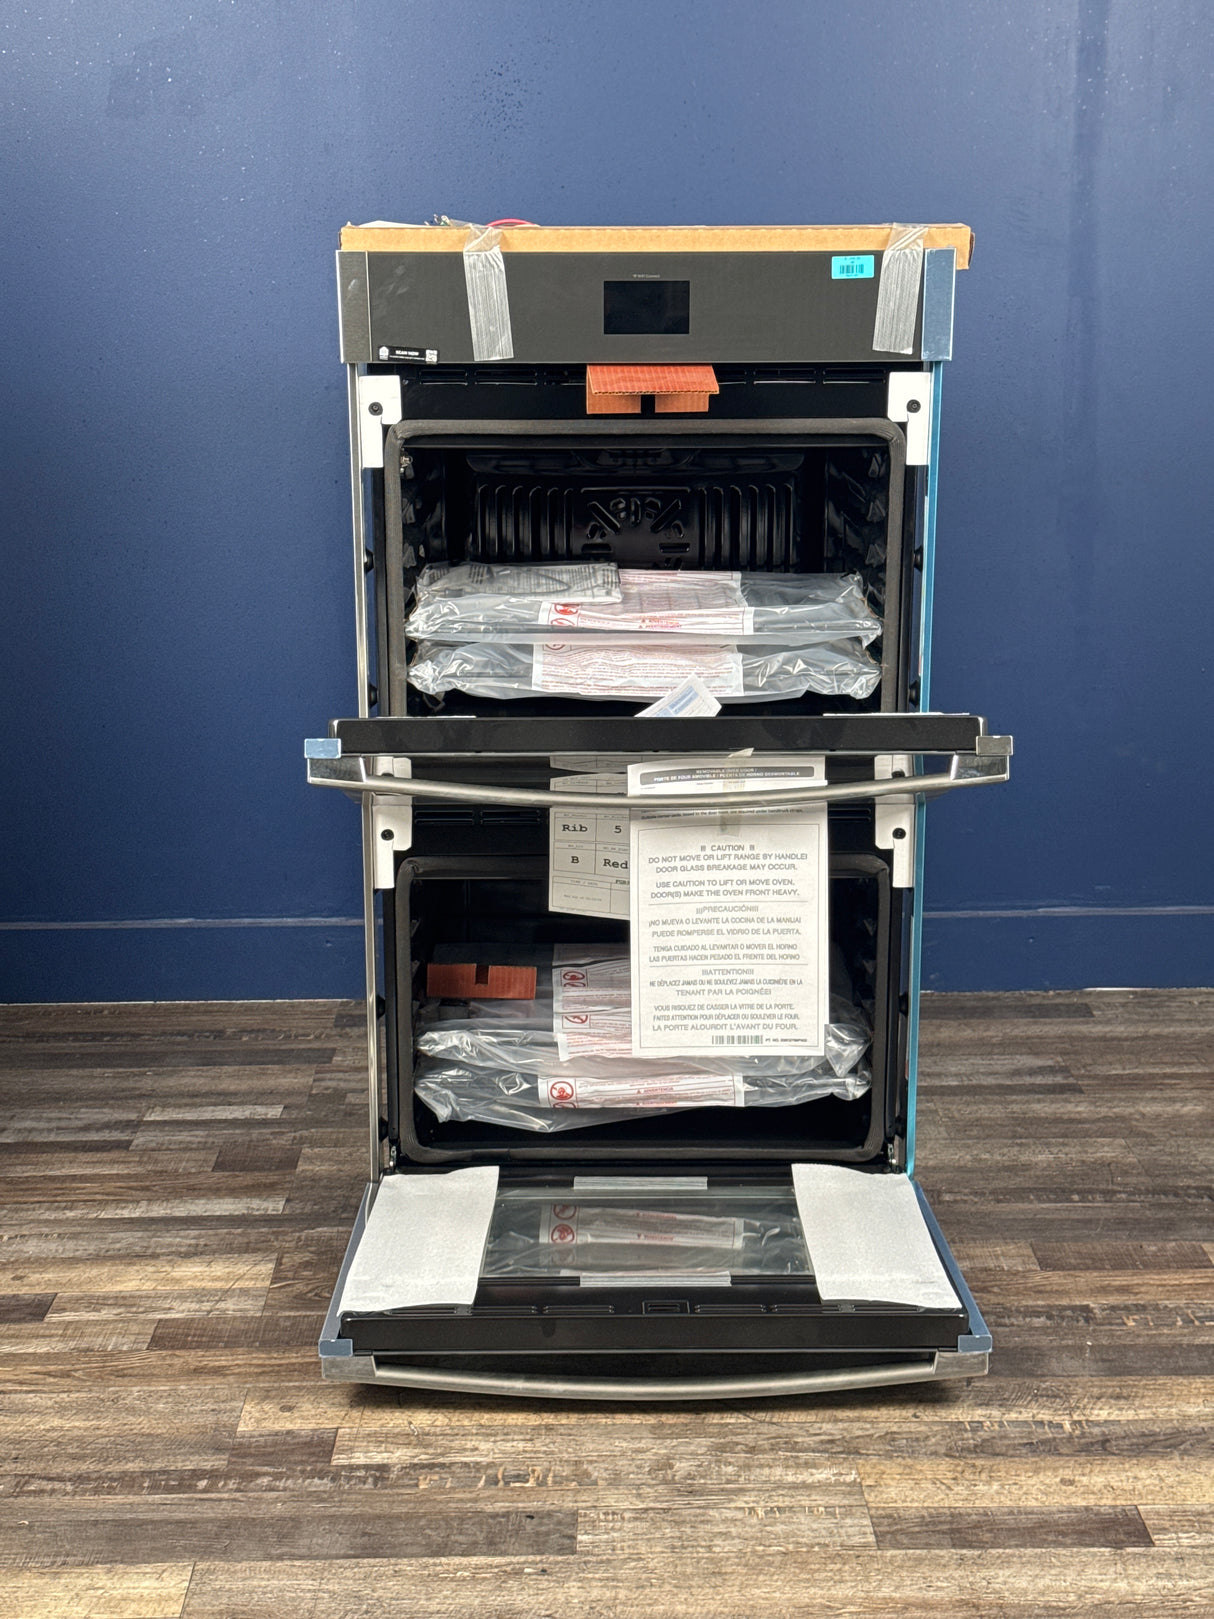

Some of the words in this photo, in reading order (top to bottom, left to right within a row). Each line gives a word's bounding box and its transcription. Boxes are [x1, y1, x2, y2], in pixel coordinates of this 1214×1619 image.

[562, 824, 588, 832] Rib
[614, 825, 622, 834] 5
[679, 854, 701, 862] MOVE
[571, 856, 580, 864] B
[603, 859, 629, 870] Red
[673, 880, 705, 888] CAUTION
[651, 891, 681, 899] DOOR(S)
[677, 929, 715, 937] ROMPERSE
